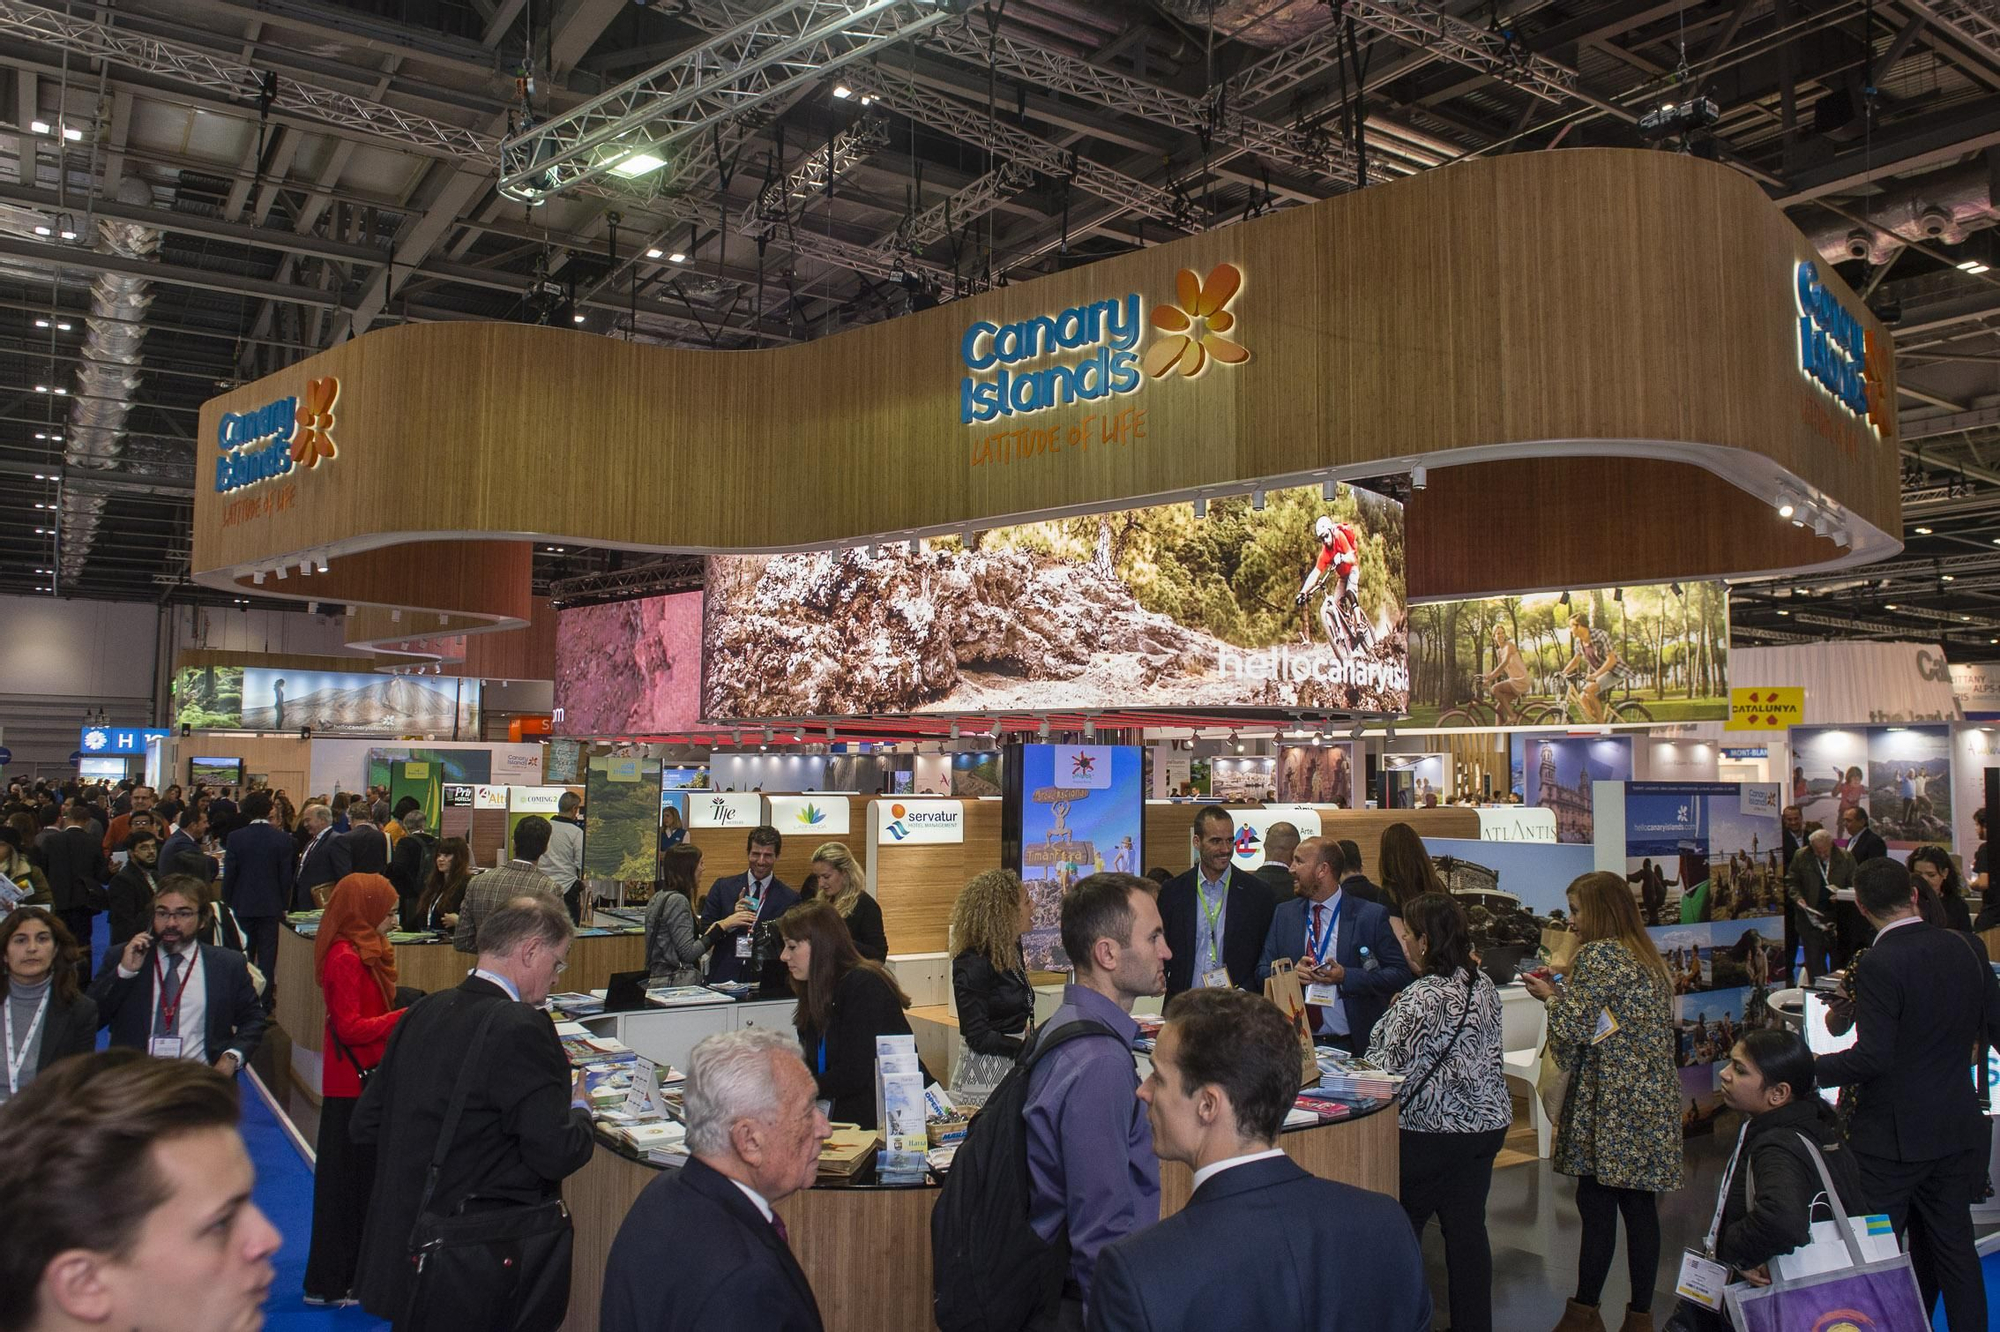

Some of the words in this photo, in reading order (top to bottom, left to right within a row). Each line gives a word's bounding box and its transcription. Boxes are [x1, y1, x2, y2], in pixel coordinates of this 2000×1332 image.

[961, 293, 1140, 370] Canary
[961, 347, 1140, 424] Islands
[218, 396, 297, 450] Canary
[971, 425, 1060, 466] LATITUDE
[1102, 409, 1148, 446] LIFE
[215, 438, 293, 493] Islands
[1732, 705, 1797, 713] CATALUNYA
[118, 734, 133, 748] H
[909, 811, 957, 822] servatur
[1483, 820, 1556, 840] ATLANTIS
